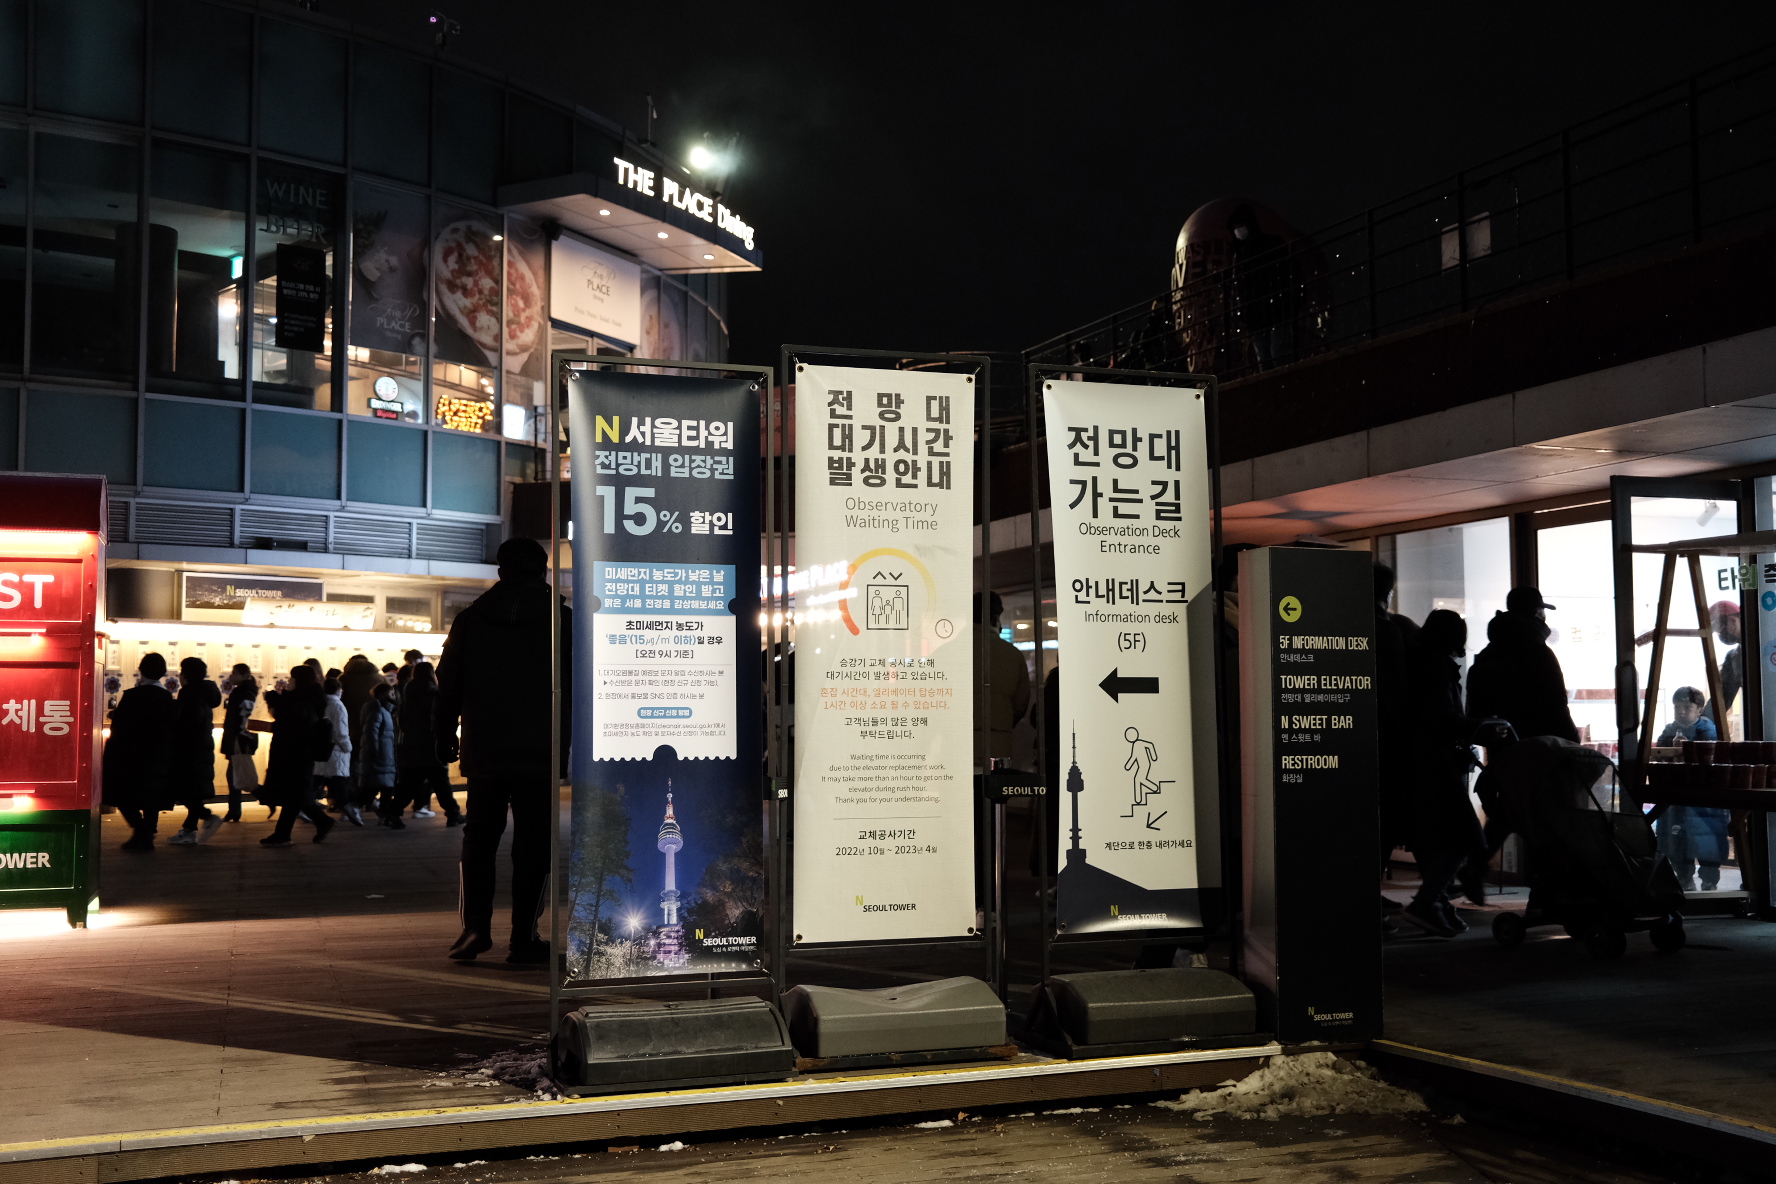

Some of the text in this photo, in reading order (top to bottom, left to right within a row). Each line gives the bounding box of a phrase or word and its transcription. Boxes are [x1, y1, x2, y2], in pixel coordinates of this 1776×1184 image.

[266, 178, 327, 209] WINE
[614, 157, 754, 250] THE PLACE Dining
[266, 214, 327, 243] BEER
[587, 279, 610, 296] PLACE
[377, 317, 411, 332] PLACE
[596, 415, 733, 449] N 서울타워
[1067, 425, 1181, 472] 전망대
[595, 451, 734, 479] 전망대 입장권
[1068, 476, 1182, 521] 가는길
[596, 486, 733, 535] 15% 할인
[845, 497, 938, 516] Observatory
[845, 515, 938, 532] Waiting Time
[1079, 522, 1180, 538] Observation Deck
[1100, 541, 1160, 555] Entrance
[605, 567, 724, 582] 미세먼지 농도가 낮은 날
[1718, 564, 1757, 591] 타워
[0, 573, 55, 609] ST
[227, 585, 235, 596] N
[605, 583, 724, 596] 전망대 티켓 할인 받고
[1072, 578, 1188, 605] 안내데스크
[605, 599, 724, 609] 맑은 서울 전경을 감상해보세요
[1084, 611, 1179, 624] Information desk
[626, 621, 704, 631] 초미세먼지 농도가
[707, 636, 723, 645] 경우
[1117, 632, 1146, 652] (5F)
[1280, 636, 1369, 650] 5F INFORMATION DESK
[635, 649, 693, 659] [오전 9시 기준]
[1280, 653, 1314, 663] 안내데스크
[840, 658, 935, 668] 승강기 교체 공사로 인해
[826, 671, 948, 680] 대기시간이 발생하고 있습니다.
[1280, 675, 1371, 689] TOWER ELEVATOR
[820, 687, 953, 698] 혼잡 시간대, 엘리베이터 탑승까지
[1281, 694, 1301, 703] 전망대
[824, 700, 950, 710] 1시간 이상 소요 될 수 있습니다.
[1, 699, 74, 736] 체통
[844, 717, 928, 727] 고객님들의 많은 양해
[1281, 716, 1353, 729] N SWEET BAR
[860, 730, 915, 740] 부탁드립니다.
[1282, 734, 1289, 743] 엔
[1314, 734, 1321, 743] 바
[888, 764, 928, 772] replacement
[1282, 755, 1338, 769] RESTROOM
[1282, 773, 1303, 783] 화장실
[894, 795, 940, 803] understanding.
[858, 829, 916, 840] 교체공사기간
[836, 845, 937, 856] 2022년 10월 2023년 4월
[1104, 839, 1193, 850] 계단으로 한층 내려가세요
[855, 895, 864, 906] N
[1111, 905, 1119, 916] N
[696, 929, 704, 939] N
[1308, 1006, 1314, 1015] N
